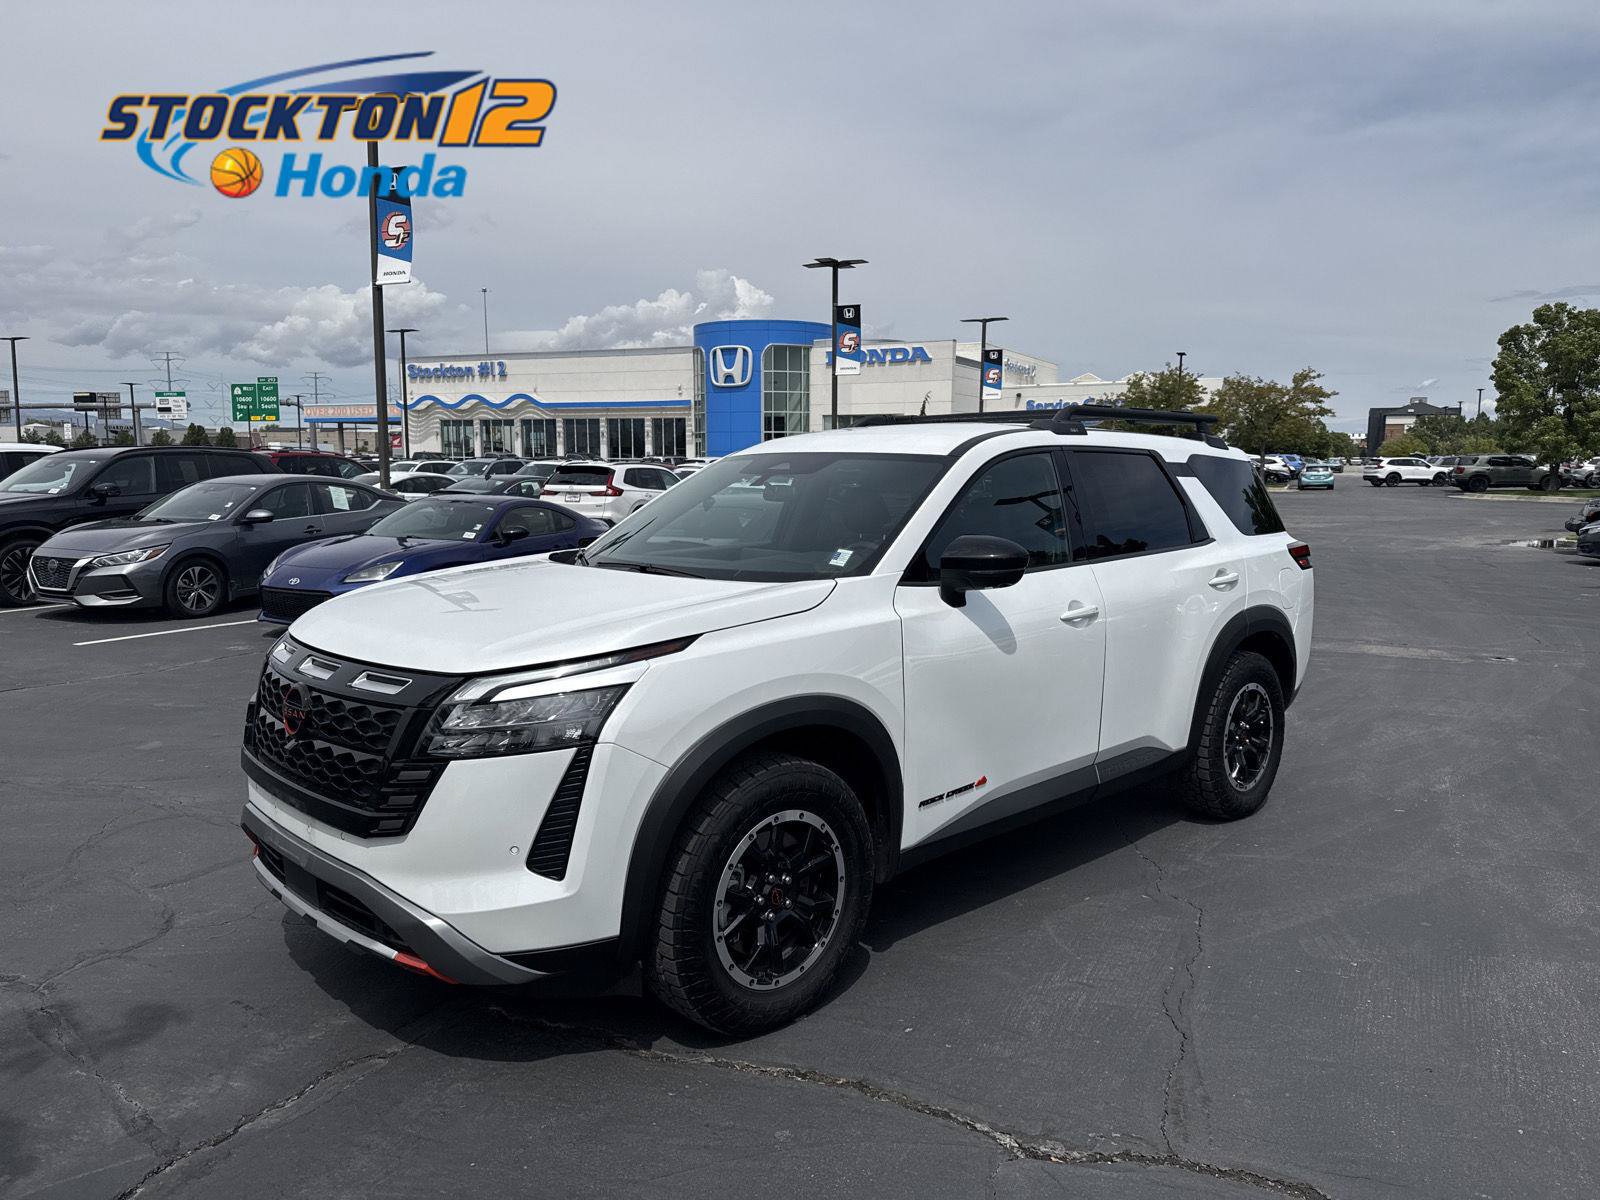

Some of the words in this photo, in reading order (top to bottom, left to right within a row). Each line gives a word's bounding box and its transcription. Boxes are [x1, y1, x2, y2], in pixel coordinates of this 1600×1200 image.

[407, 362, 473, 379] Stockton
[305, 407, 329, 417] OVER
[332, 406, 348, 416] 200
[349, 406, 374, 416] USED
